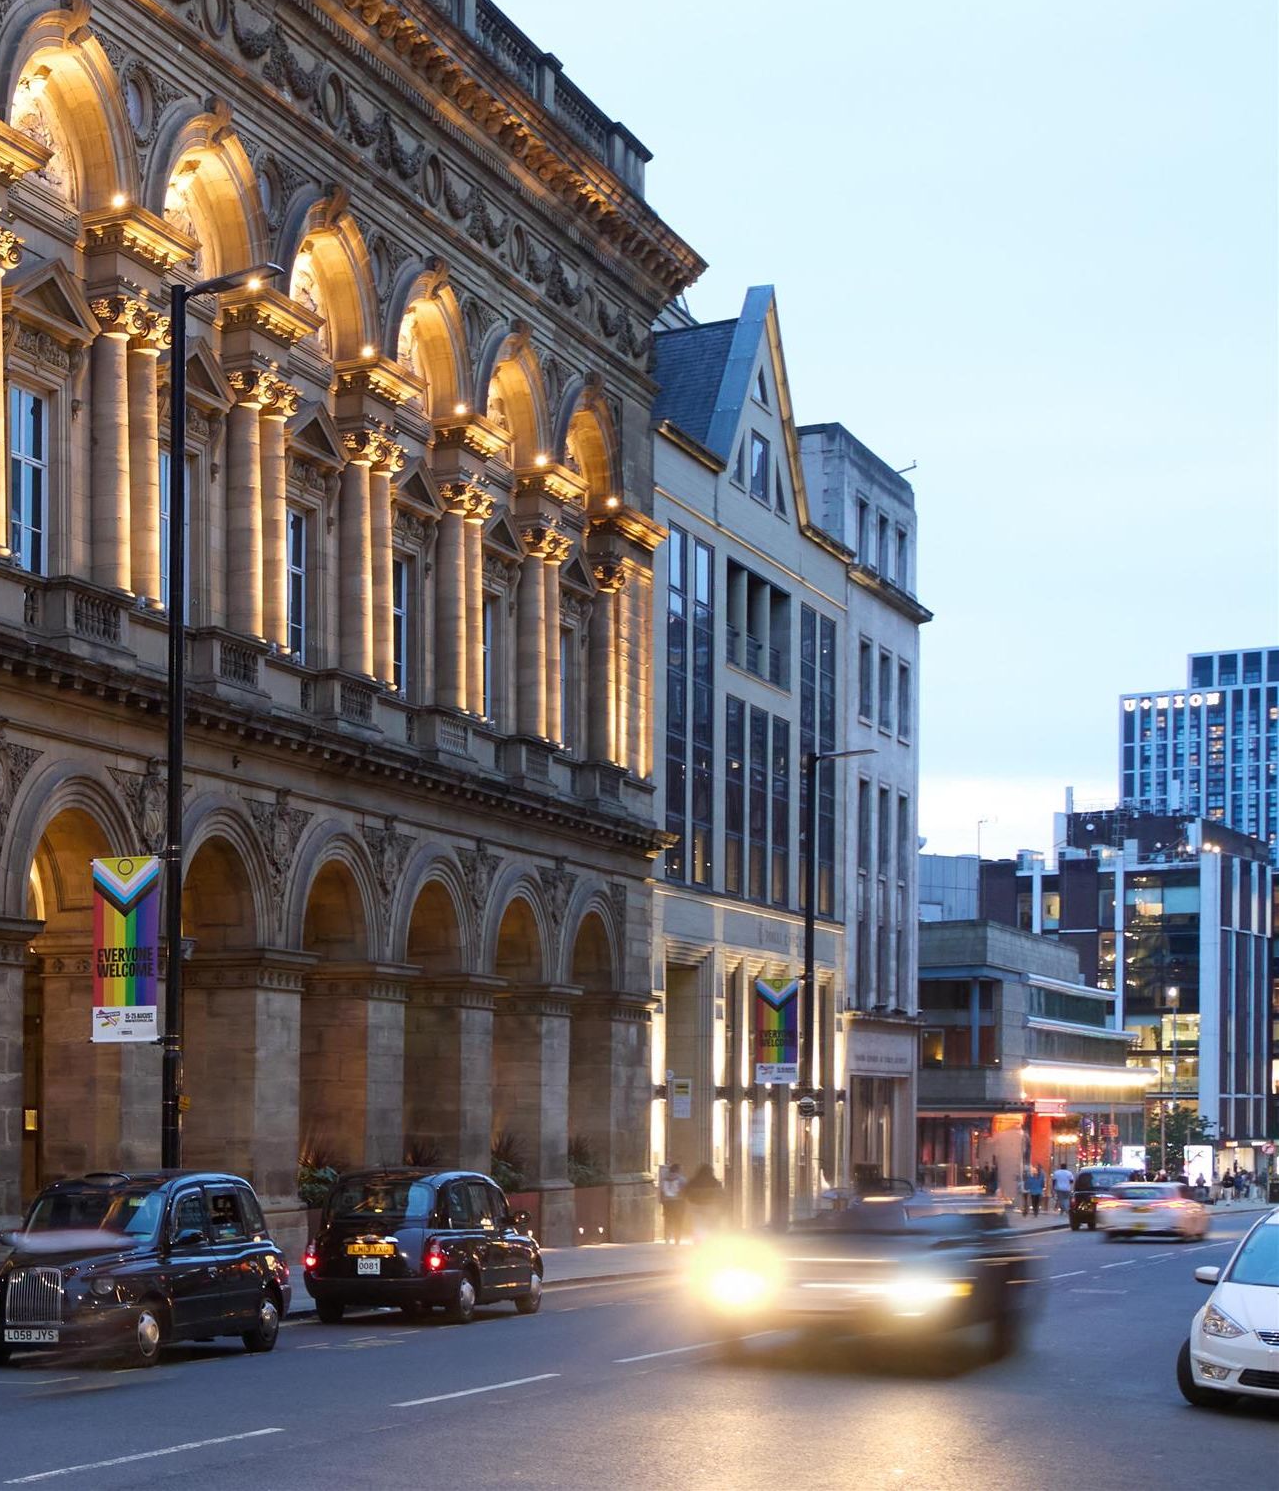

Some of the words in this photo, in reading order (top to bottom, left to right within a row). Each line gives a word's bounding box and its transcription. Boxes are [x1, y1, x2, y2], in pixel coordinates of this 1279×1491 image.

[97, 947, 154, 962] EVERYONE
[96, 962, 155, 978] WELCOME
[358, 1262, 379, 1270] 0081
[7, 1330, 32, 1340] LO58
[35, 1330, 54, 1340] JYS
